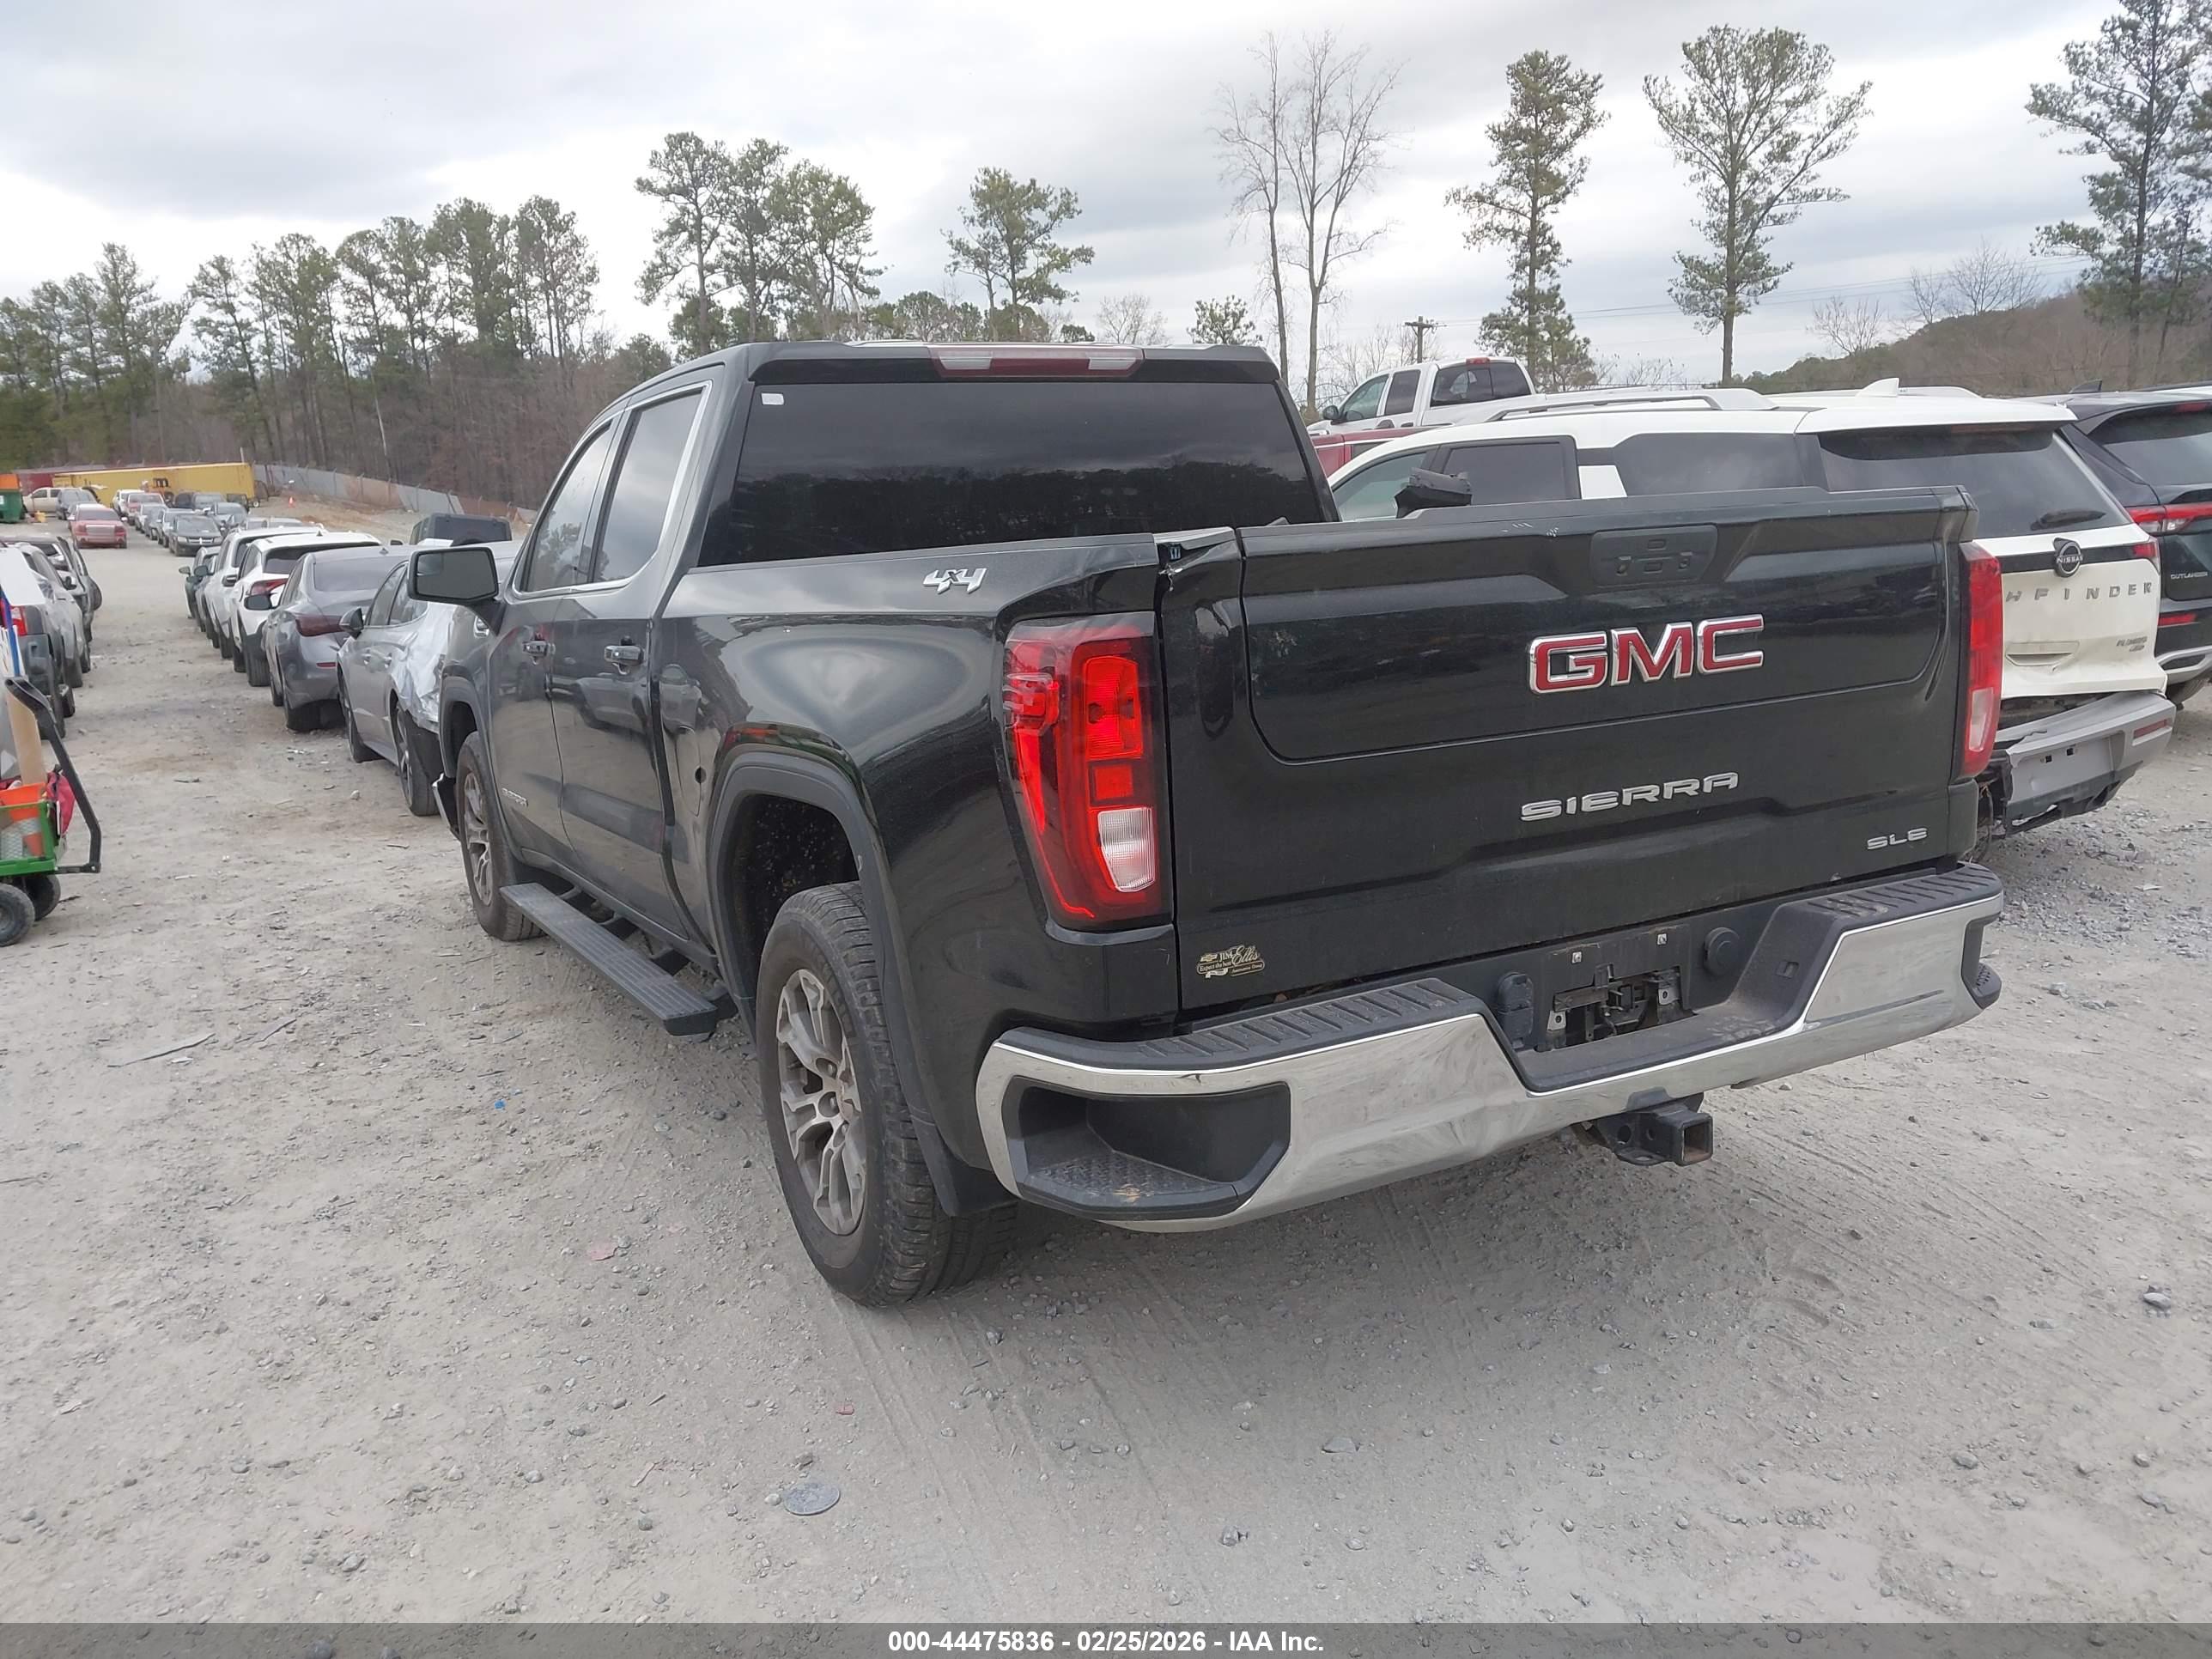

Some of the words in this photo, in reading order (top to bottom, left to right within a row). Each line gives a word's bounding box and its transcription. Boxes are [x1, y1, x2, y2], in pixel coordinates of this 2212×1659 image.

[2056, 556, 2084, 564] NISSAN
[1528, 614, 1764, 694] GMC
[1521, 772, 1739, 822] SIERRA
[1866, 827, 1928, 850] SLE
